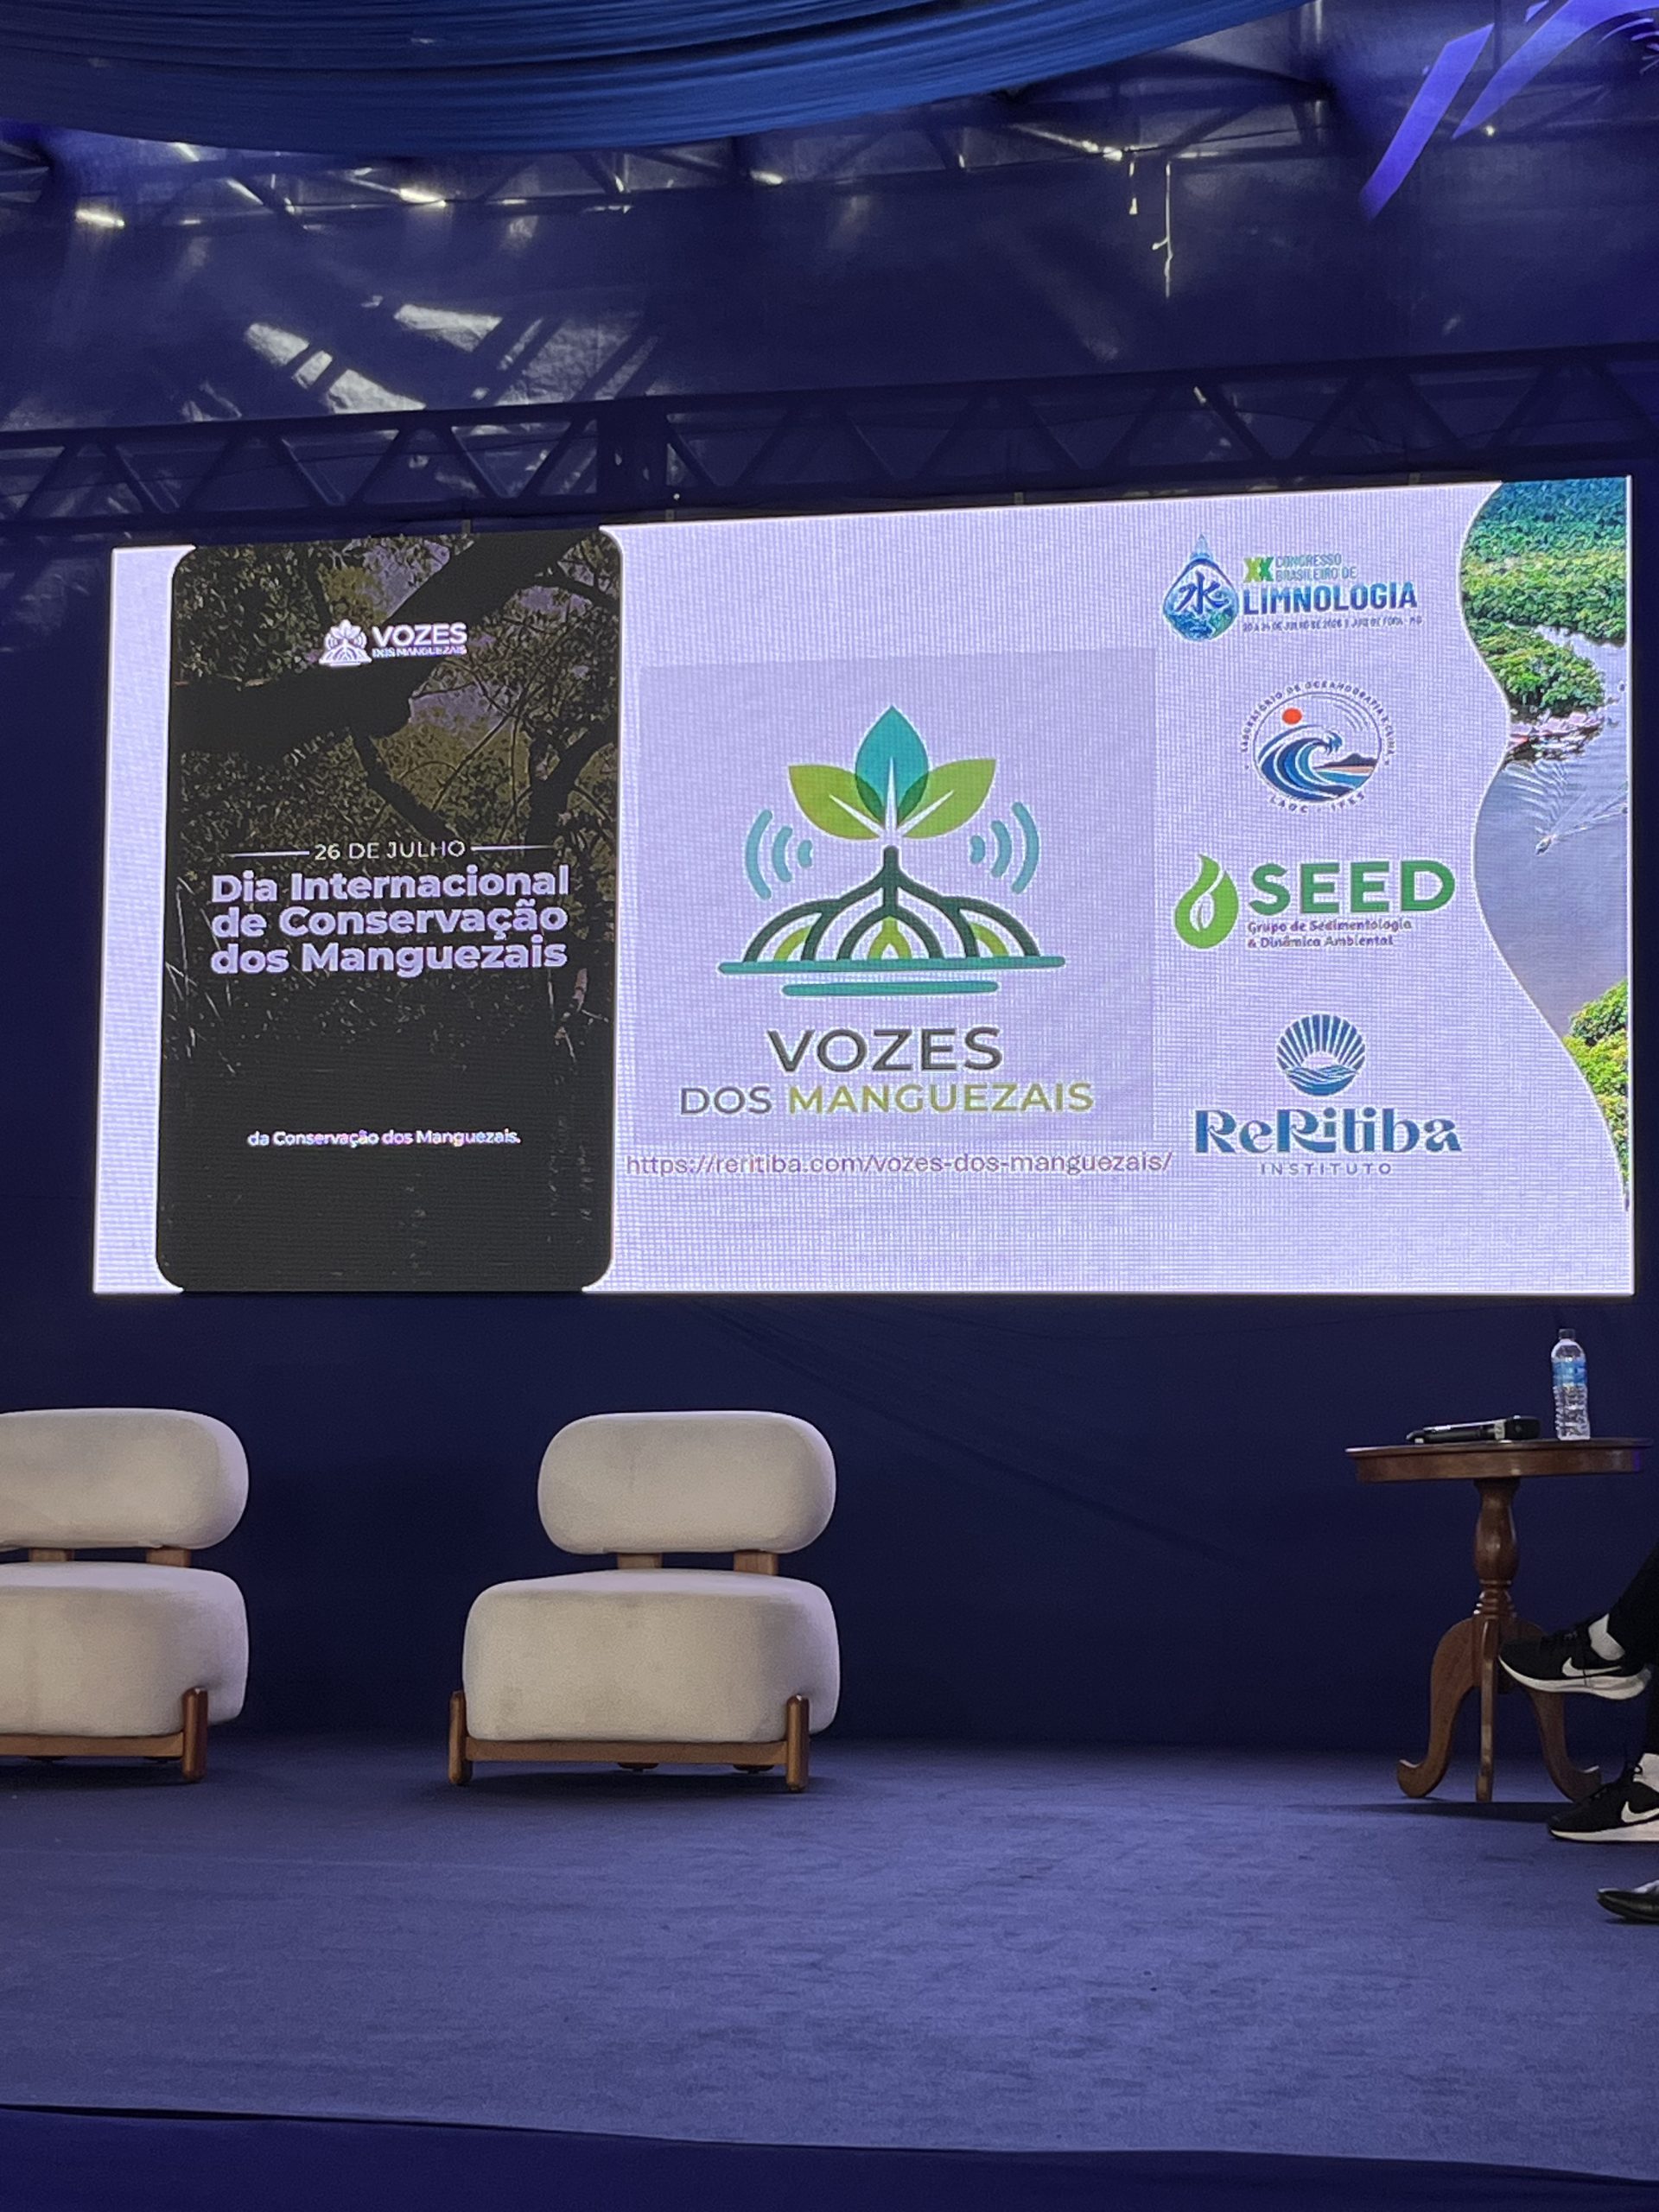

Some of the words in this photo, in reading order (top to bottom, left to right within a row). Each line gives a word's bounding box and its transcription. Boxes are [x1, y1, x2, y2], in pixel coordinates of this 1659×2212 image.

[1275, 553, 1342, 568] CONGRESSO
[1275, 568, 1338, 582] BRASILEIRO
[1341, 566, 1357, 580] DE
[1243, 581, 1418, 615] LIMNOLOGIA
[372, 622, 468, 647] VOZES
[314, 844, 341, 861] 26
[349, 842, 379, 860] DE
[385, 840, 466, 860] JULHO
[211, 869, 278, 904] Dia
[290, 864, 570, 901] Internacional
[1249, 860, 1455, 916] SEED
[211, 906, 267, 938] de
[278, 899, 569, 941] Conservação
[1247, 921, 1287, 935] Grupo
[1290, 921, 1307, 933] de
[1309, 918, 1413, 933] Sedimentologia
[1260, 936, 1321, 948] Dinâmica
[1325, 935, 1394, 947] Ambiental
[210, 943, 289, 975] dos
[301, 934, 569, 979] Manguezais
[767, 1027, 1003, 1073] VOZES
[679, 1085, 772, 1116] DOS
[788, 1081, 1095, 1116] MANGUEZAIS
[247, 1130, 270, 1147] da
[272, 1129, 379, 1148] Conservação
[381, 1129, 415, 1147] dos
[416, 1128, 522, 1147] Manguezais.
[1194, 1107, 1463, 1154] ReRitiba
[626, 1150, 1174, 1177] https://reritiba.com/vozes-dos-manguezais/
[1260, 1162, 1392, 1176] INSTITUTO
